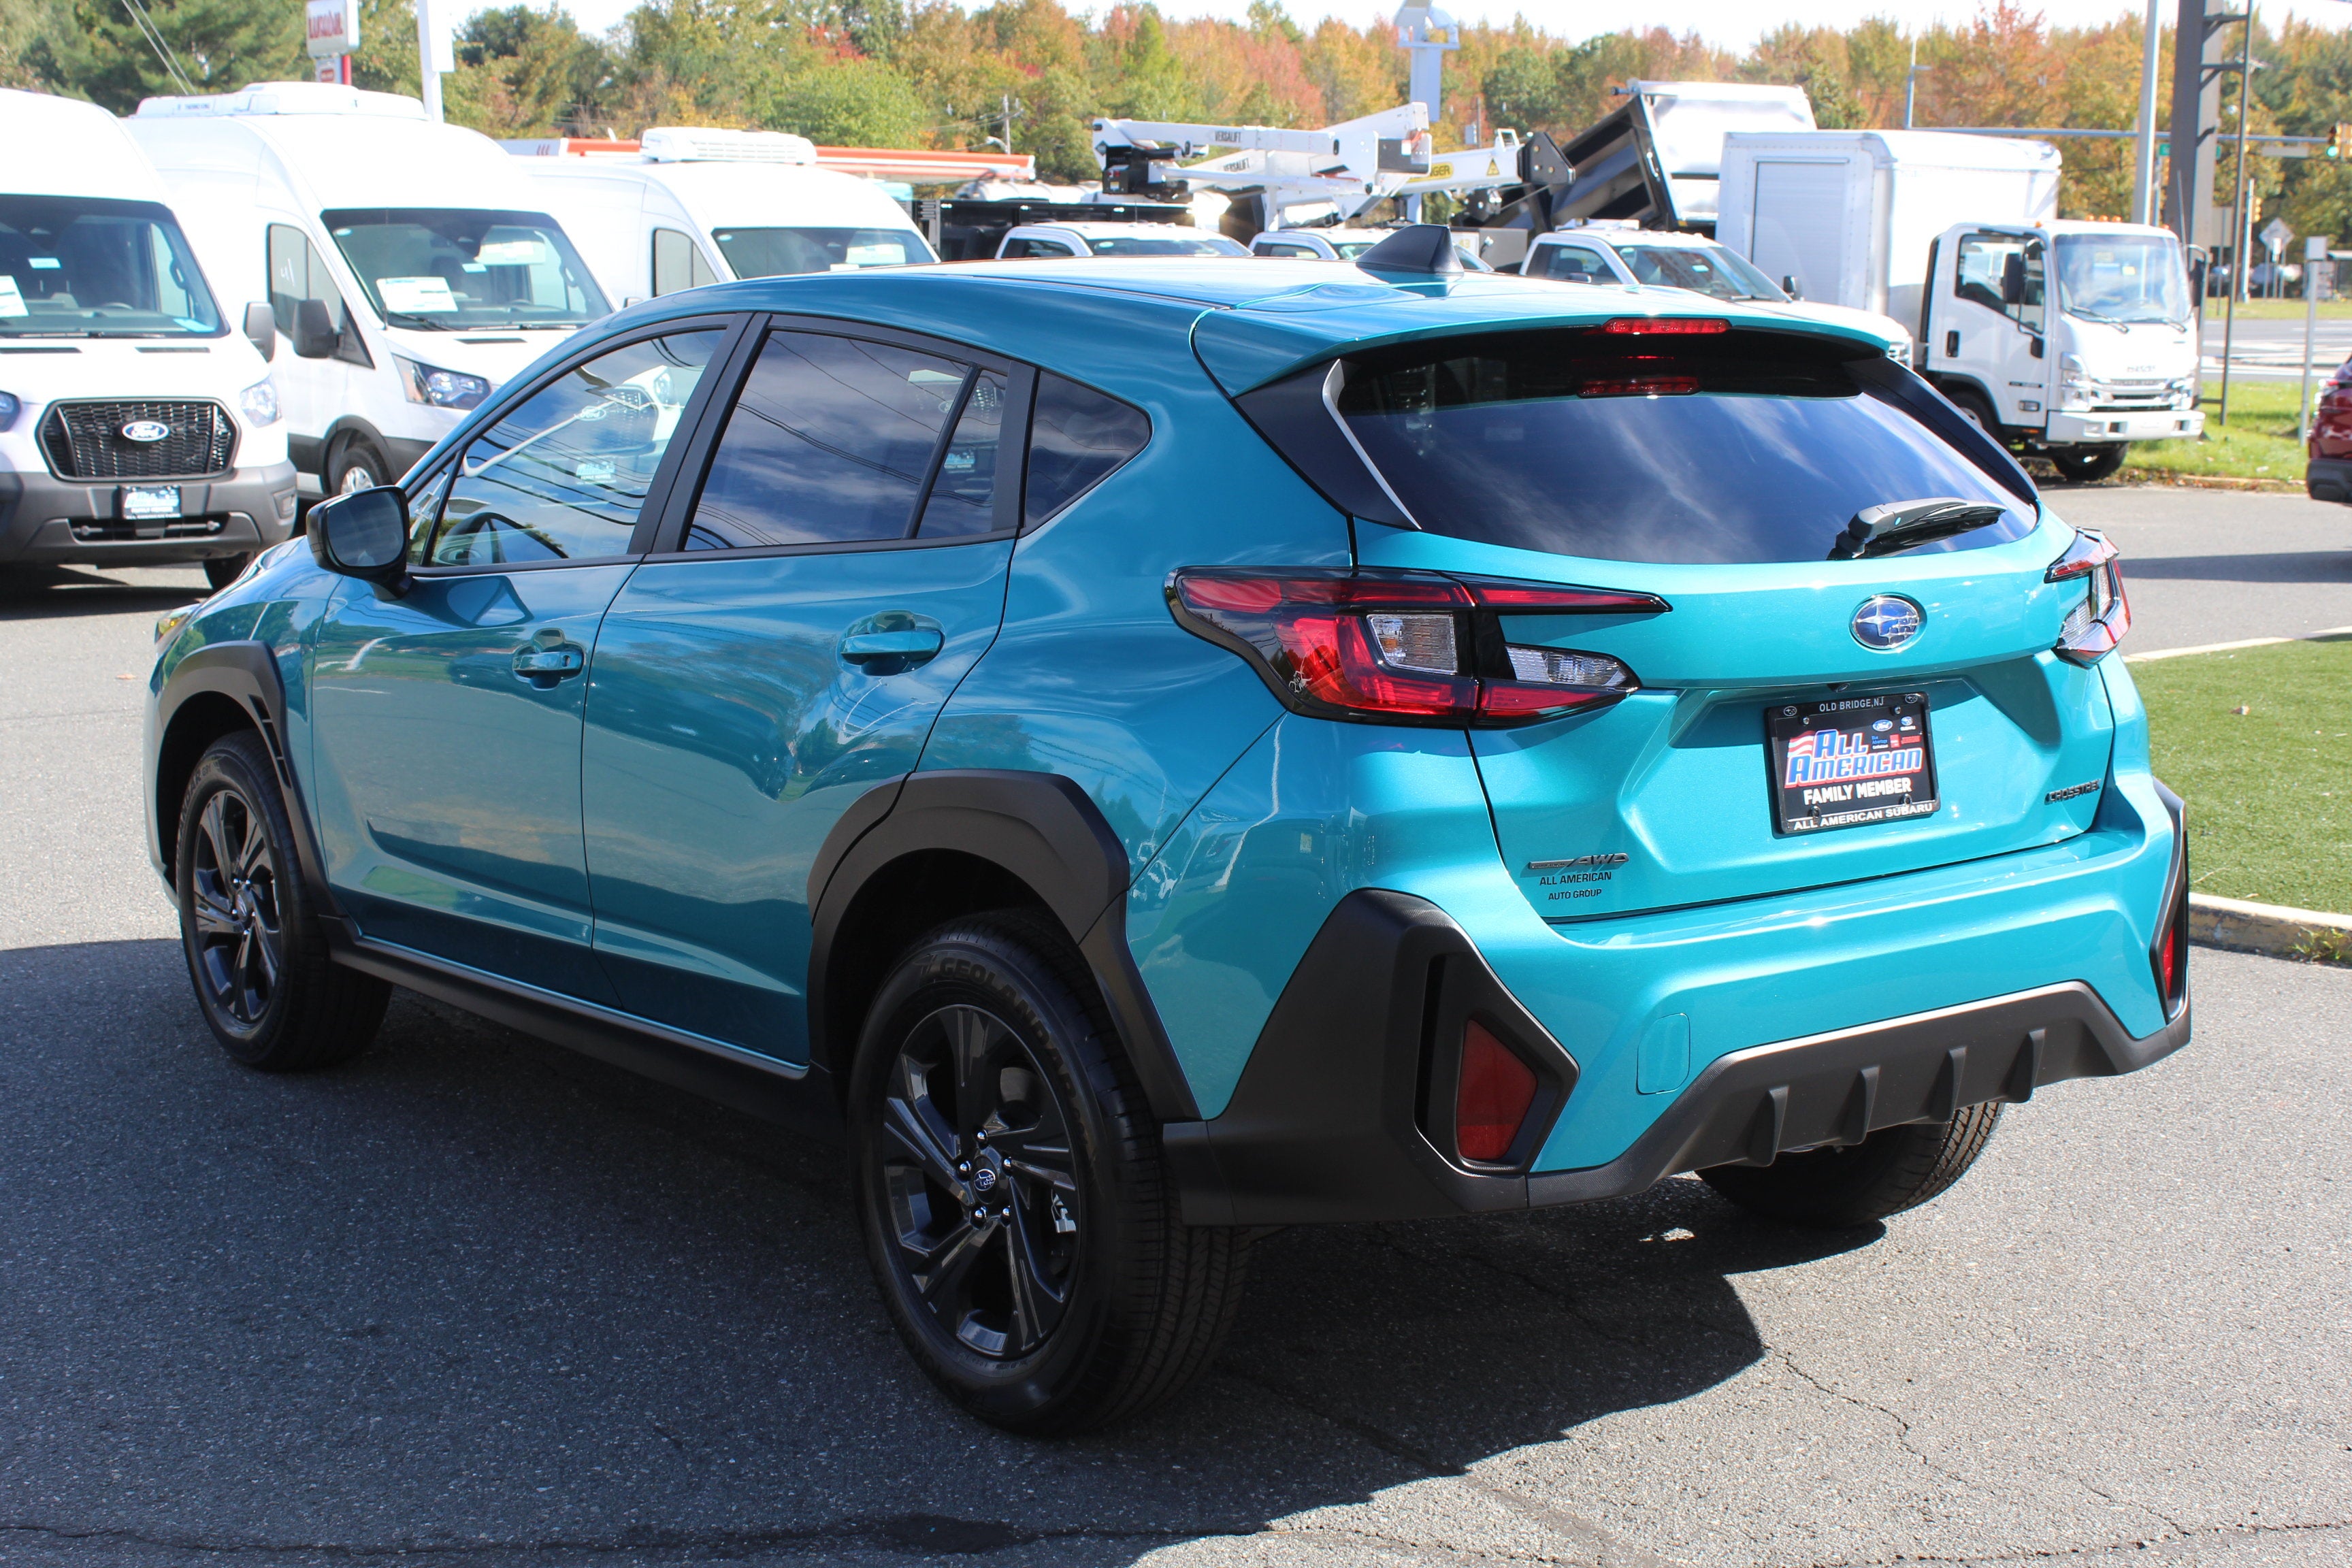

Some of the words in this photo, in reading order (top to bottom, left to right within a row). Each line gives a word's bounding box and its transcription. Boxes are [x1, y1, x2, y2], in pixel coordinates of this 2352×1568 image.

[1215, 131, 1241, 142] VERSALIFT
[1819, 702, 1836, 713] OLD
[1803, 783, 1855, 805] FAMILY
[1857, 777, 1912, 799] MEMBER
[2048, 779, 2102, 802] CROSSTREK
[1793, 819, 1818, 830] ALL
[1820, 809, 1883, 826] AMERICAN
[1886, 804, 1933, 817] SUBARU
[1568, 853, 1629, 867] AWD
[1539, 875, 1556, 885] ALL
[1560, 871, 1612, 884] AMERICAN
[1548, 890, 1571, 900] AUTO
[1573, 889, 1602, 898] GROUP
[939, 957, 1077, 1100] GEOLANDAR
